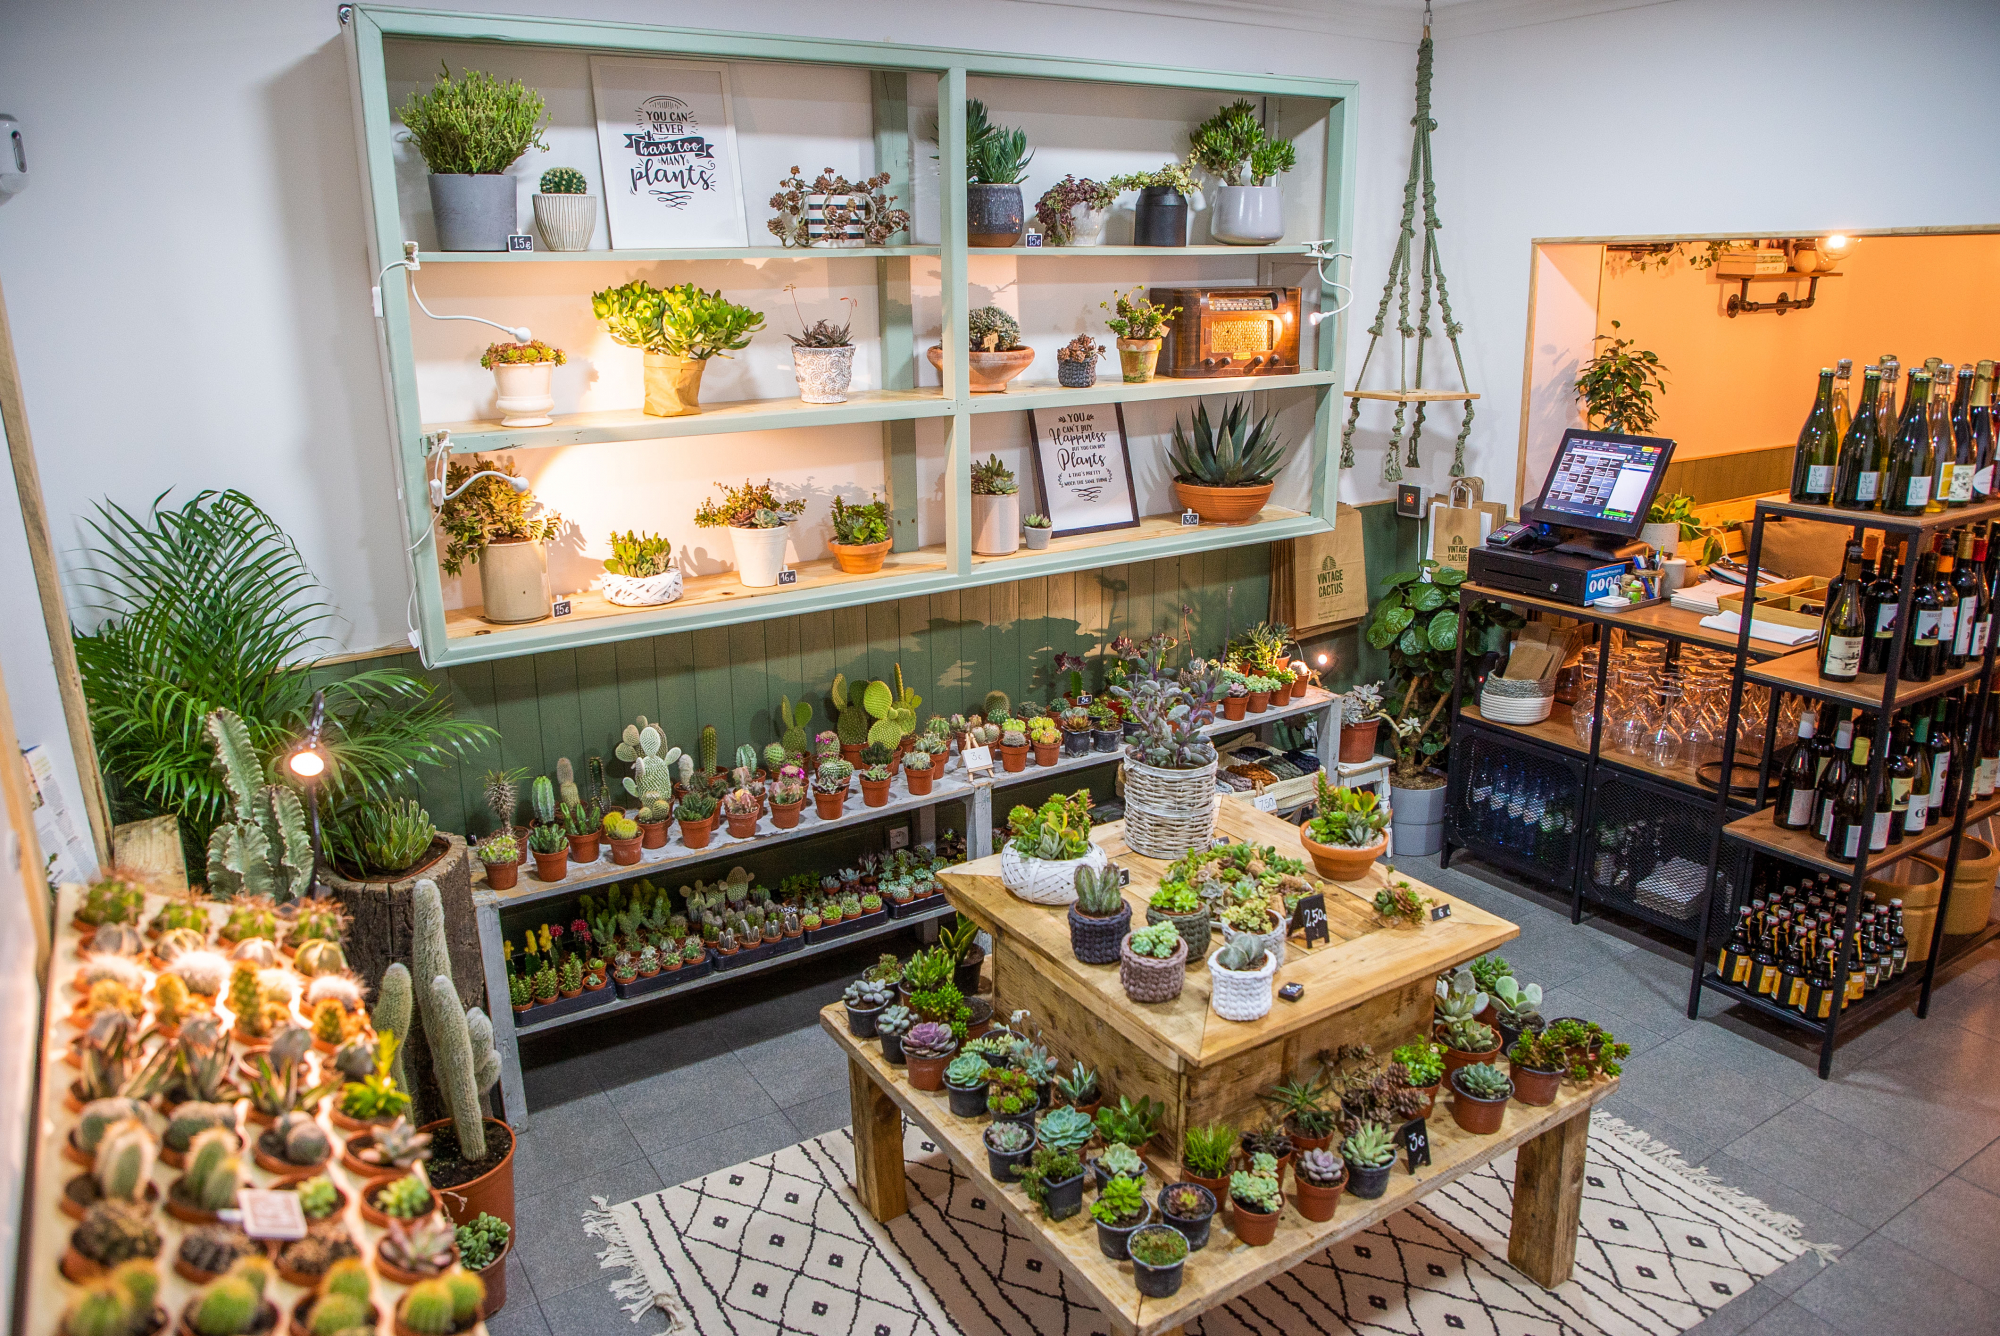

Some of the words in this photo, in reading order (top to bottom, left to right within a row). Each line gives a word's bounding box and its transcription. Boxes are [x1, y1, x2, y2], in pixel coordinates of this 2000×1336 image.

[646, 111, 666, 121] YOU
[670, 112, 688, 122] CAN
[653, 124, 684, 134] NEVER
[640, 142, 675, 156] have
[676, 140, 701, 151] too
[661, 154, 686, 166] MANY
[630, 158, 714, 192] plants
[514, 237, 531, 250] 15€
[1028, 237, 1041, 246] 15€
[1067, 412, 1086, 423] YOU
[1062, 424, 1079, 433] CAN'T
[1080, 424, 1092, 432] BUY
[1049, 427, 1107, 446] Happiness
[1057, 448, 1106, 471] Plants
[1184, 515, 1197, 524] 30€
[1447, 545, 1468, 554] VINTAGE
[1448, 553, 1468, 562] CACTUS
[781, 573, 794, 582] 16€
[1317, 570, 1344, 585] VINTAGE
[1318, 583, 1344, 598] CACTUS
[556, 605, 569, 615] 15€
[1304, 907, 1327, 927] 2,50€
[1409, 1132, 1425, 1151] 3€
